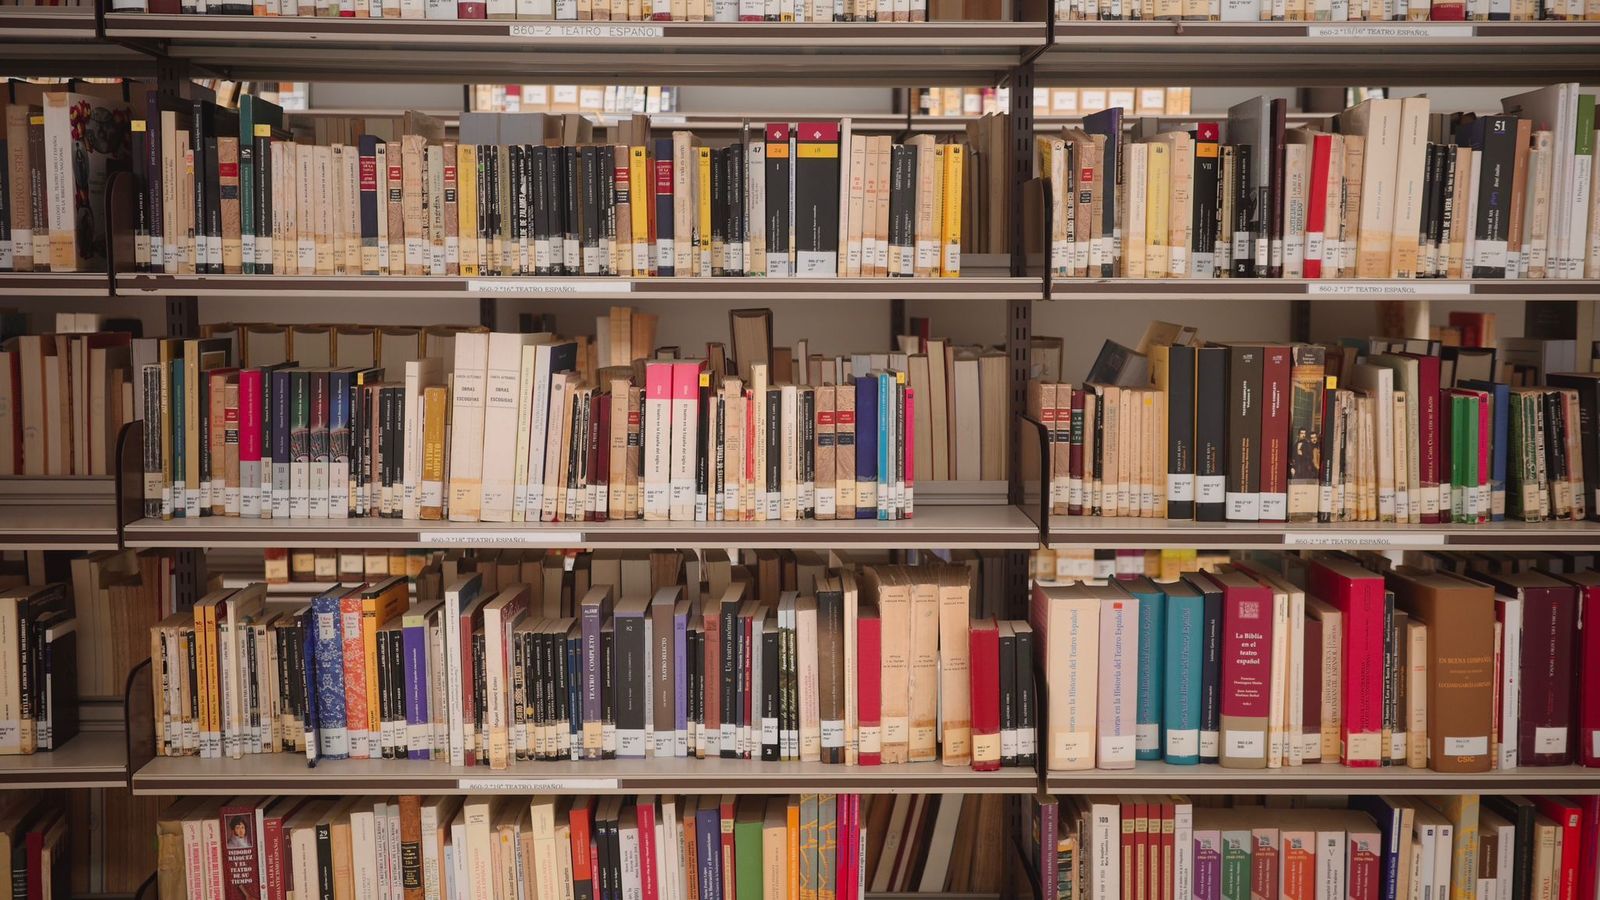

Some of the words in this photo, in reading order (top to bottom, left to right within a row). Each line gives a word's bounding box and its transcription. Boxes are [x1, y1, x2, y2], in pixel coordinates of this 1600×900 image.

[512, 26, 551, 36] 860-2
[561, 26, 601, 36] TEATRO
[610, 26, 660, 37] ESPAÑOL
[1494, 121, 1506, 131] 51
[14, 148, 23, 173] TRES
[724, 613, 733, 640] anómalo
[1070, 610, 1079, 636] Español
[1114, 610, 1124, 636] Español
[724, 642, 733, 660] teatro
[1114, 637, 1122, 658] Teatro
[724, 662, 733, 672] Un
[1237, 658, 1260, 666] español
[515, 688, 523, 704] SOBRE
[1069, 707, 1075, 715] en
[1115, 706, 1121, 714] en
